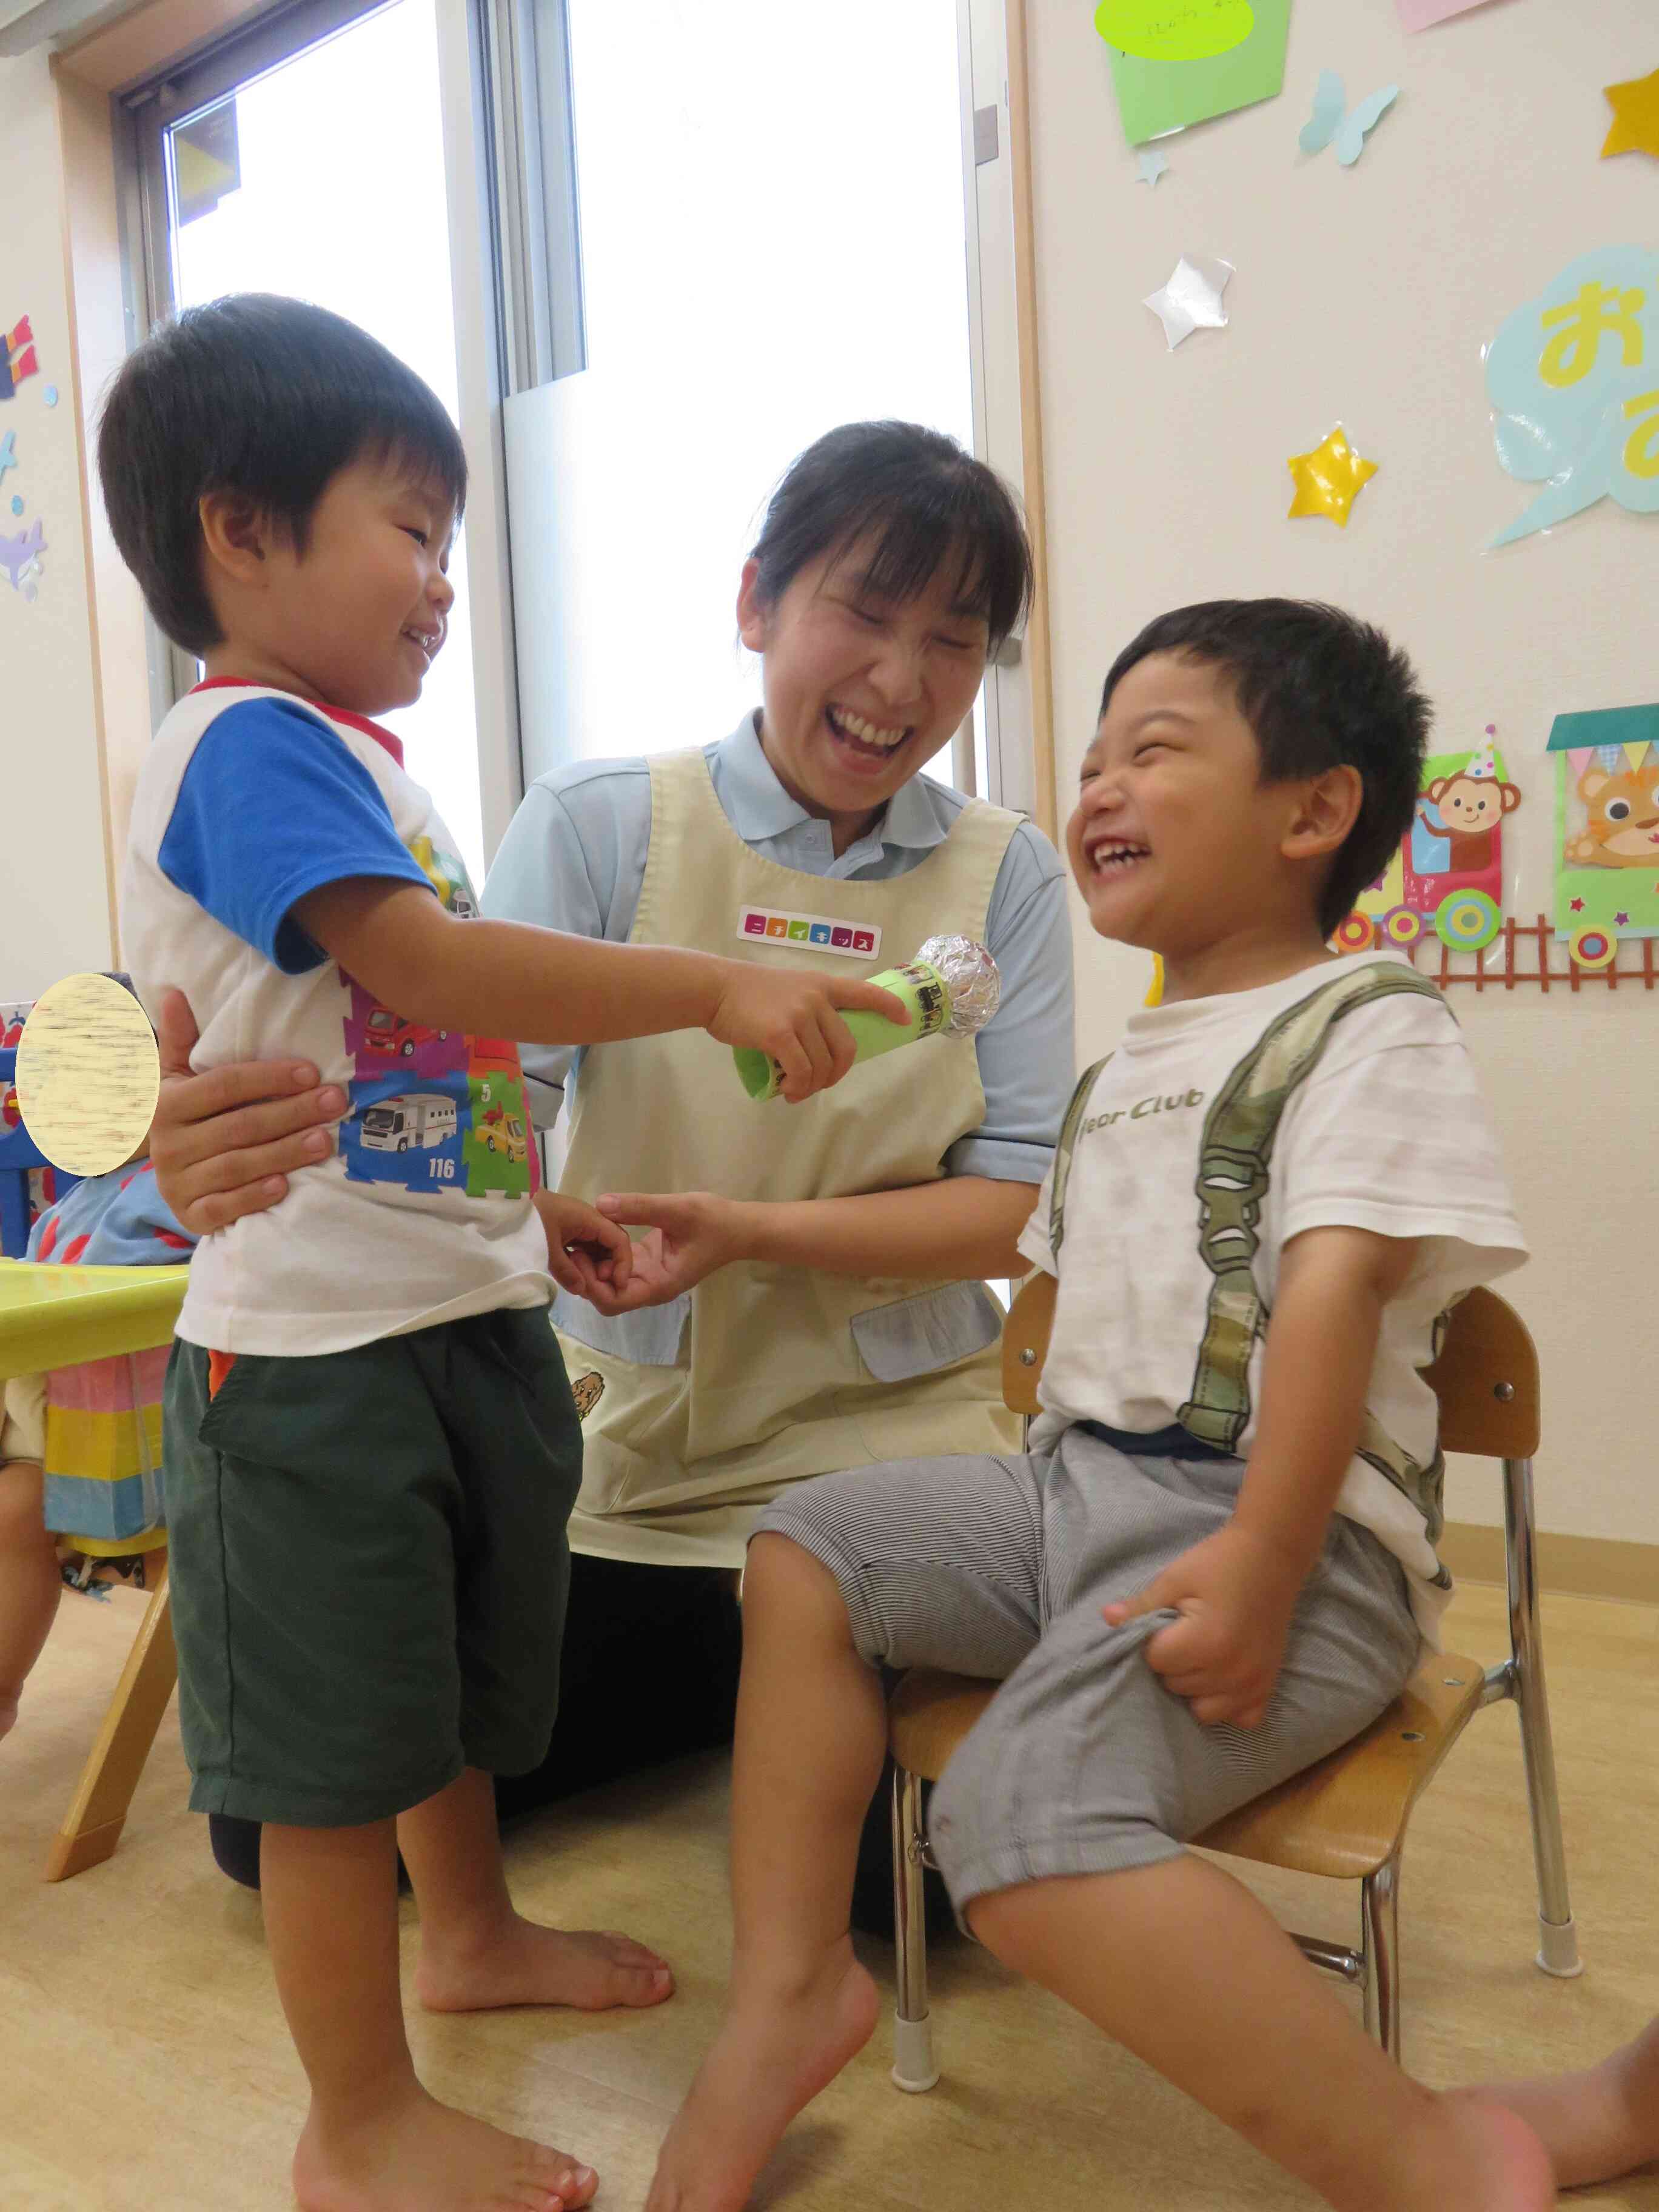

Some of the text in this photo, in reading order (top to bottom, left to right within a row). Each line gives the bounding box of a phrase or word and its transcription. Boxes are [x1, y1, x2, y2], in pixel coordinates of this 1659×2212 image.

[1538, 273, 1659, 389] お
[481, 1084, 491, 1102] 5
[1130, 1088, 1204, 1119] Club
[429, 1158, 455, 1178] 116
